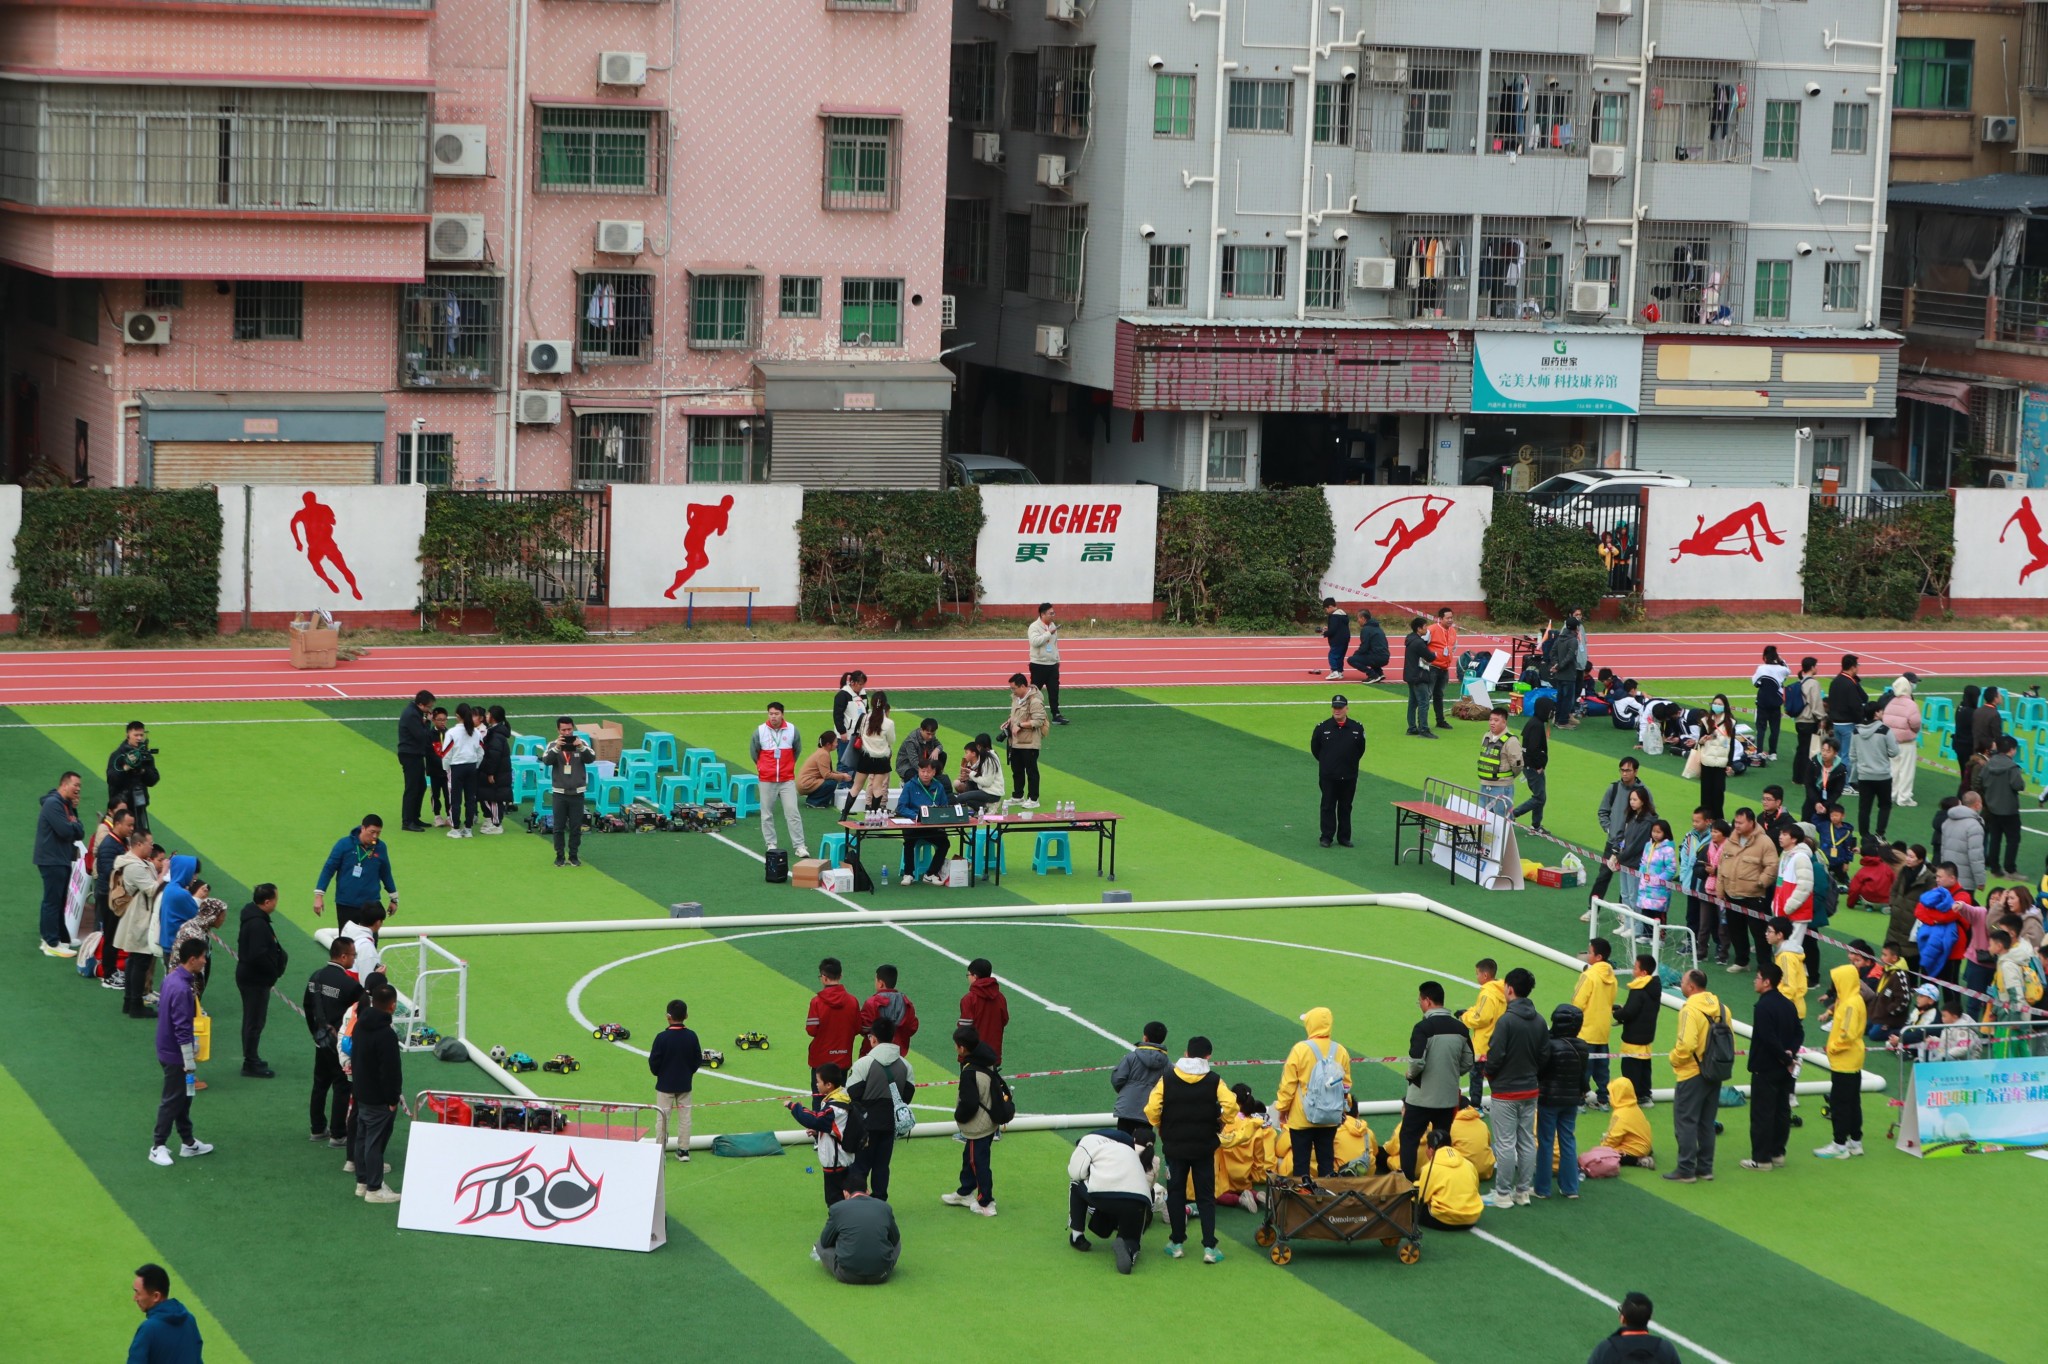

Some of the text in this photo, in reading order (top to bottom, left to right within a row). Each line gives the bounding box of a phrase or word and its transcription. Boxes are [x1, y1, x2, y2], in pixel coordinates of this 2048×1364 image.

[1541, 357, 1578, 367] 国药世家
[1499, 373, 1618, 390] 完美大师 科技康养馆
[1017, 503, 1122, 535] HIGHER
[1015, 542, 1116, 563] 更高
[454, 1145, 605, 1231] TRC
